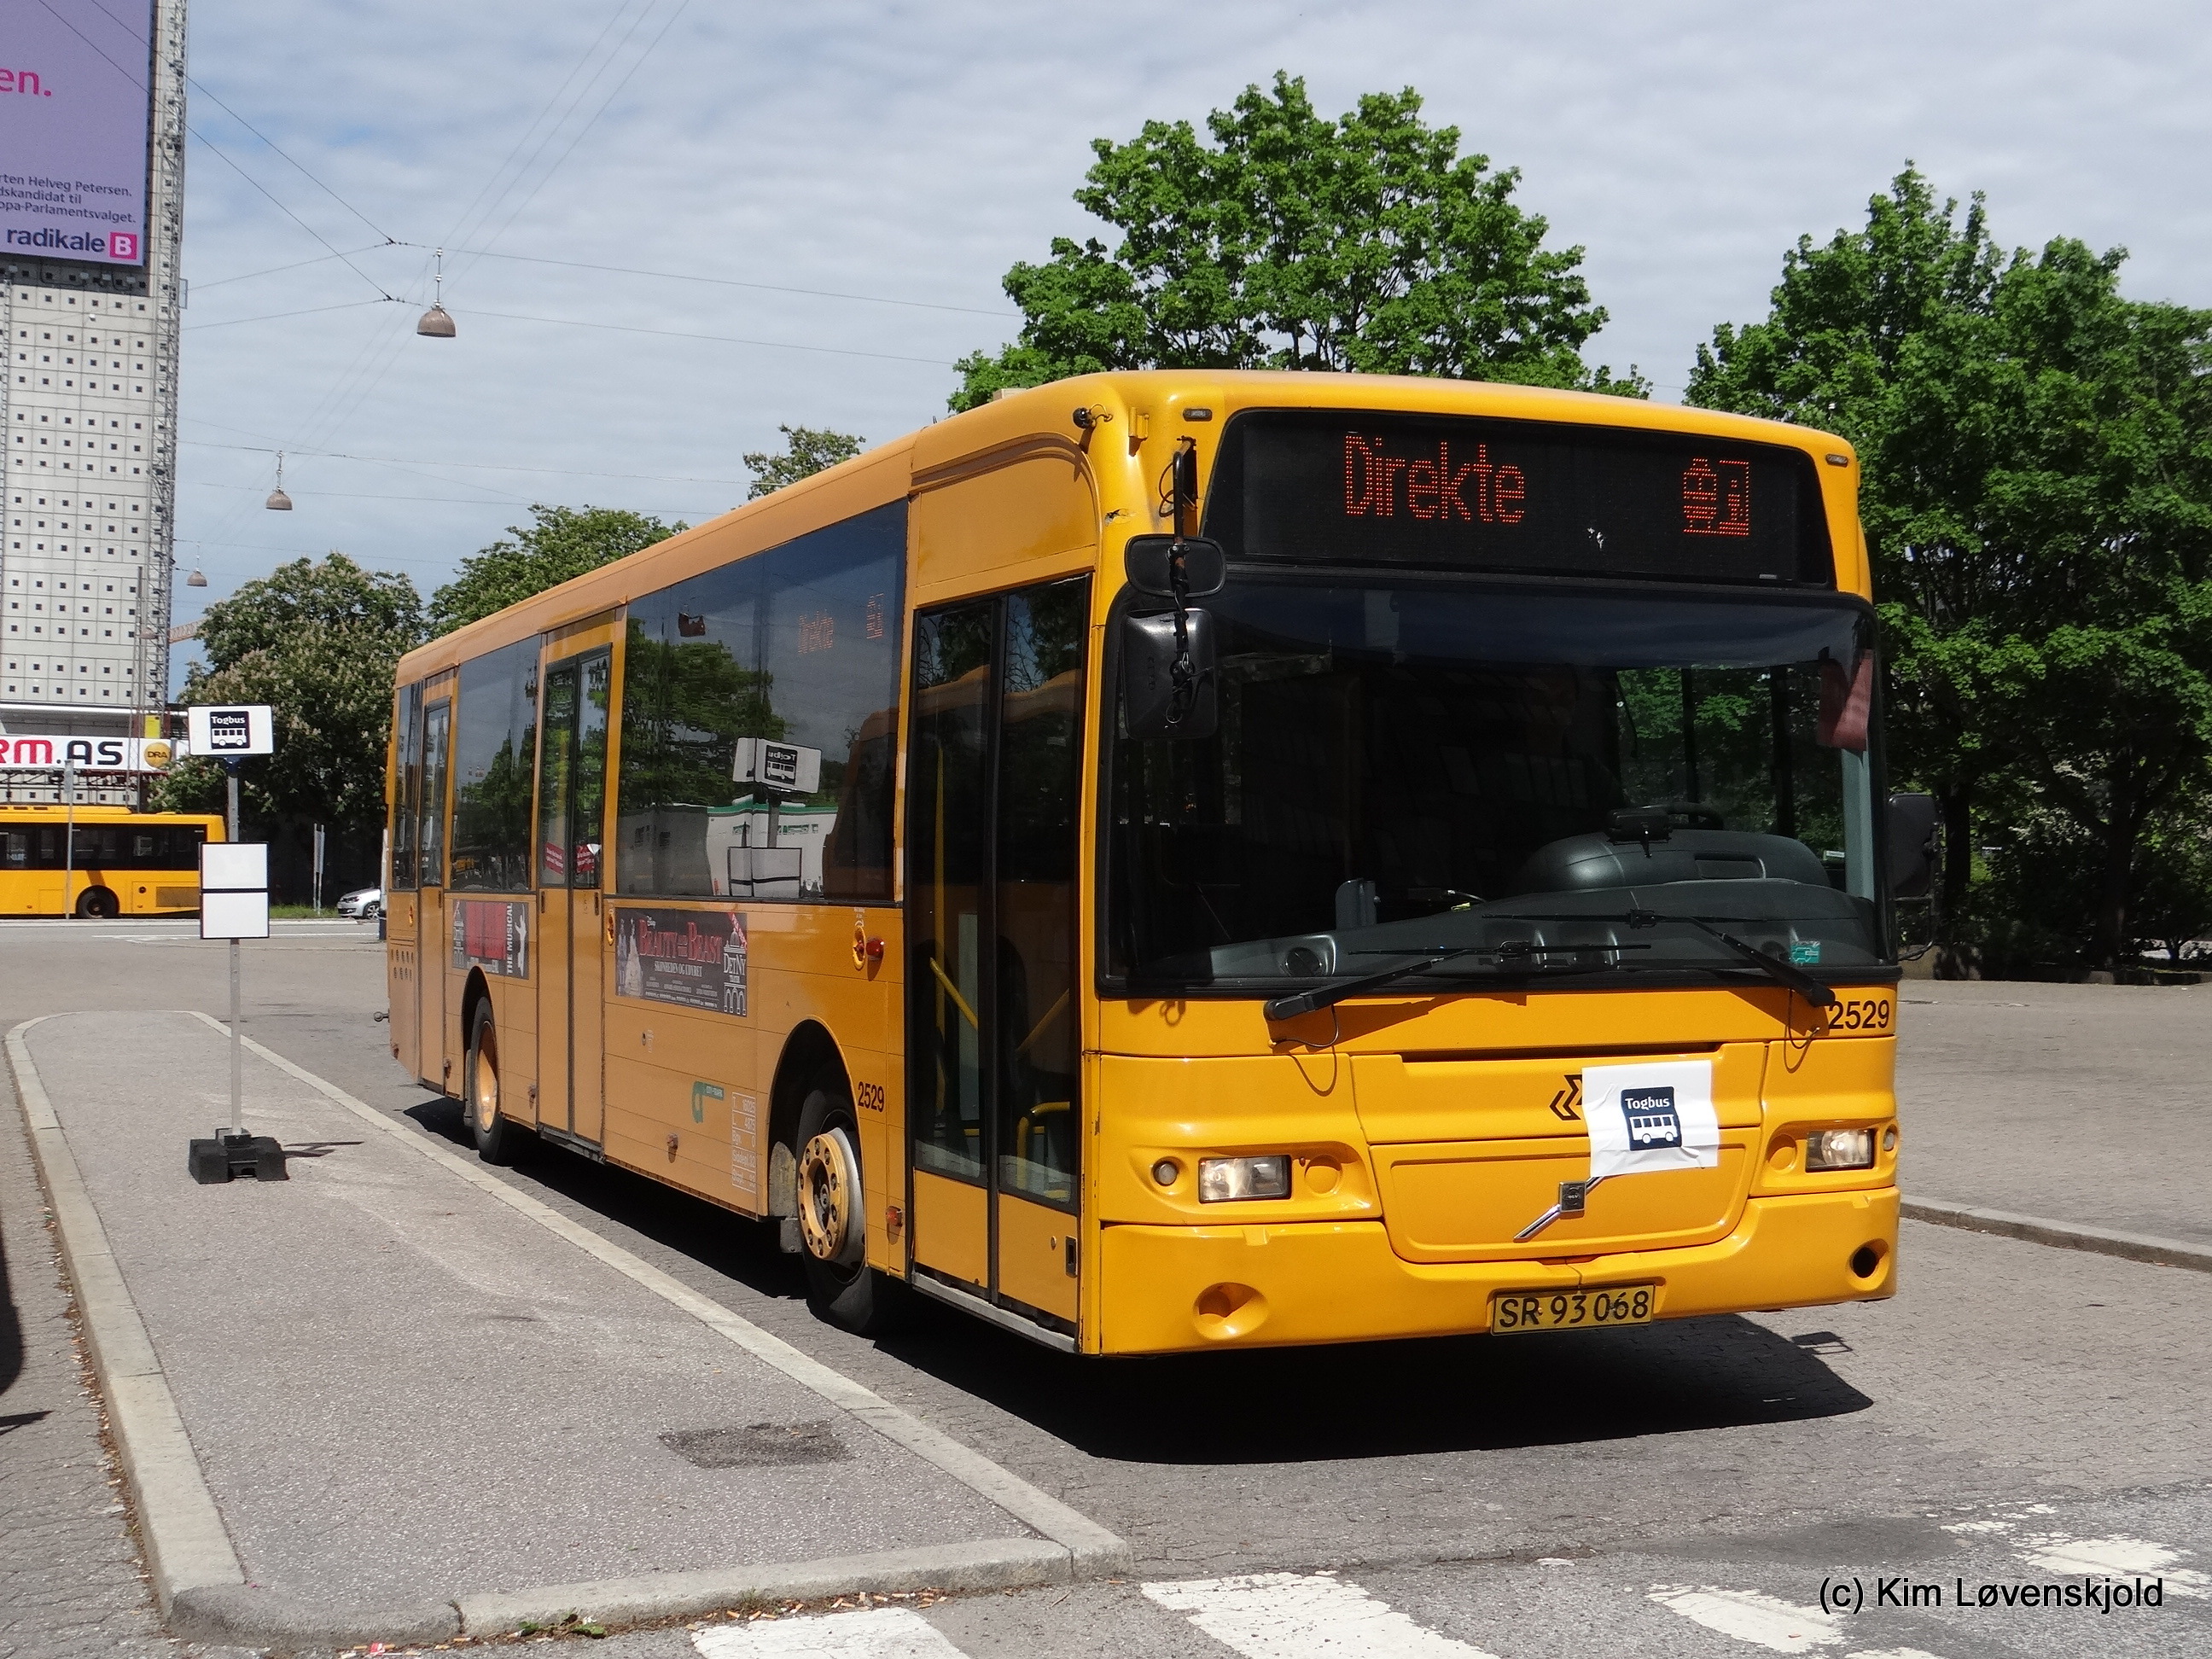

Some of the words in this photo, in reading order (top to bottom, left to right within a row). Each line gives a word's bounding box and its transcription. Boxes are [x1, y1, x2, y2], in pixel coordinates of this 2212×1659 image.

[28, 175, 71, 193] Helveg
[75, 180, 132, 197] Petersen.
[69, 193, 82, 204] til
[7, 227, 106, 253] radikale
[114, 236, 132, 256] B
[1345, 434, 1525, 524] Direkte
[211, 715, 245, 725] Togbus
[688, 922, 723, 964] BEAST
[1828, 1000, 1890, 1029] 2529
[858, 1081, 884, 1113] 2529
[1625, 1097, 1670, 1111] Togbus
[1499, 1298, 1540, 1328] SR
[1551, 1293, 1586, 1324] 93
[1593, 1290, 1650, 1320] 068
